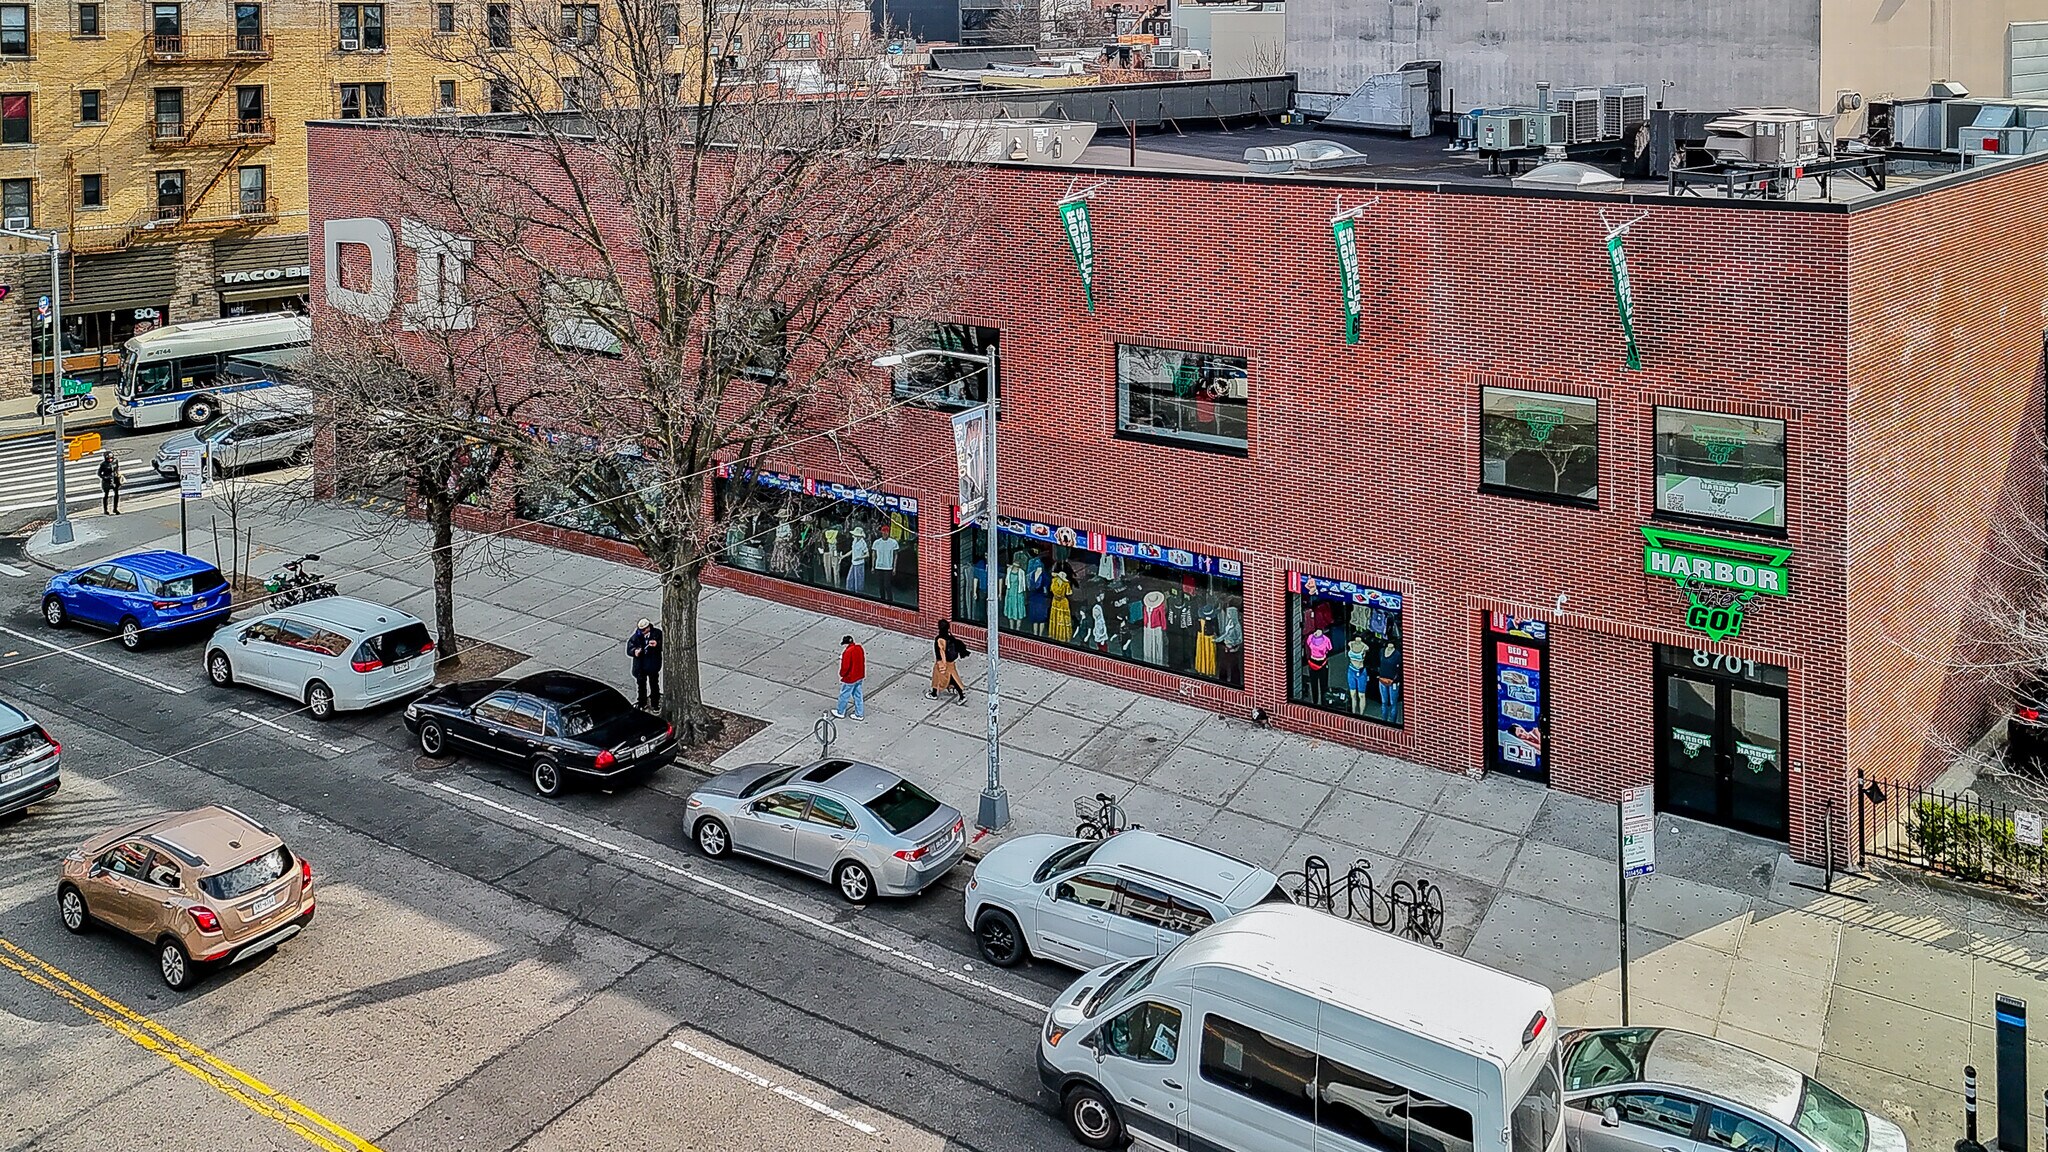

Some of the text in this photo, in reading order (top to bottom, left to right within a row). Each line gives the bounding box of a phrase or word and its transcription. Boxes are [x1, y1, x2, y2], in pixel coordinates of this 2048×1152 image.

[221, 269, 280, 283] TACO
[134, 308, 160, 320] 80s
[1700, 483, 1738, 495] HARBOR
[1651, 551, 1779, 590] HARBOR
[1677, 573, 1763, 614] fitness
[1688, 606, 1741, 633] GO!
[1507, 645, 1522, 655] BED
[1693, 649, 1755, 677] 8701
[1673, 731, 1711, 748] HARBOR
[1736, 745, 1776, 762] HARBOR
